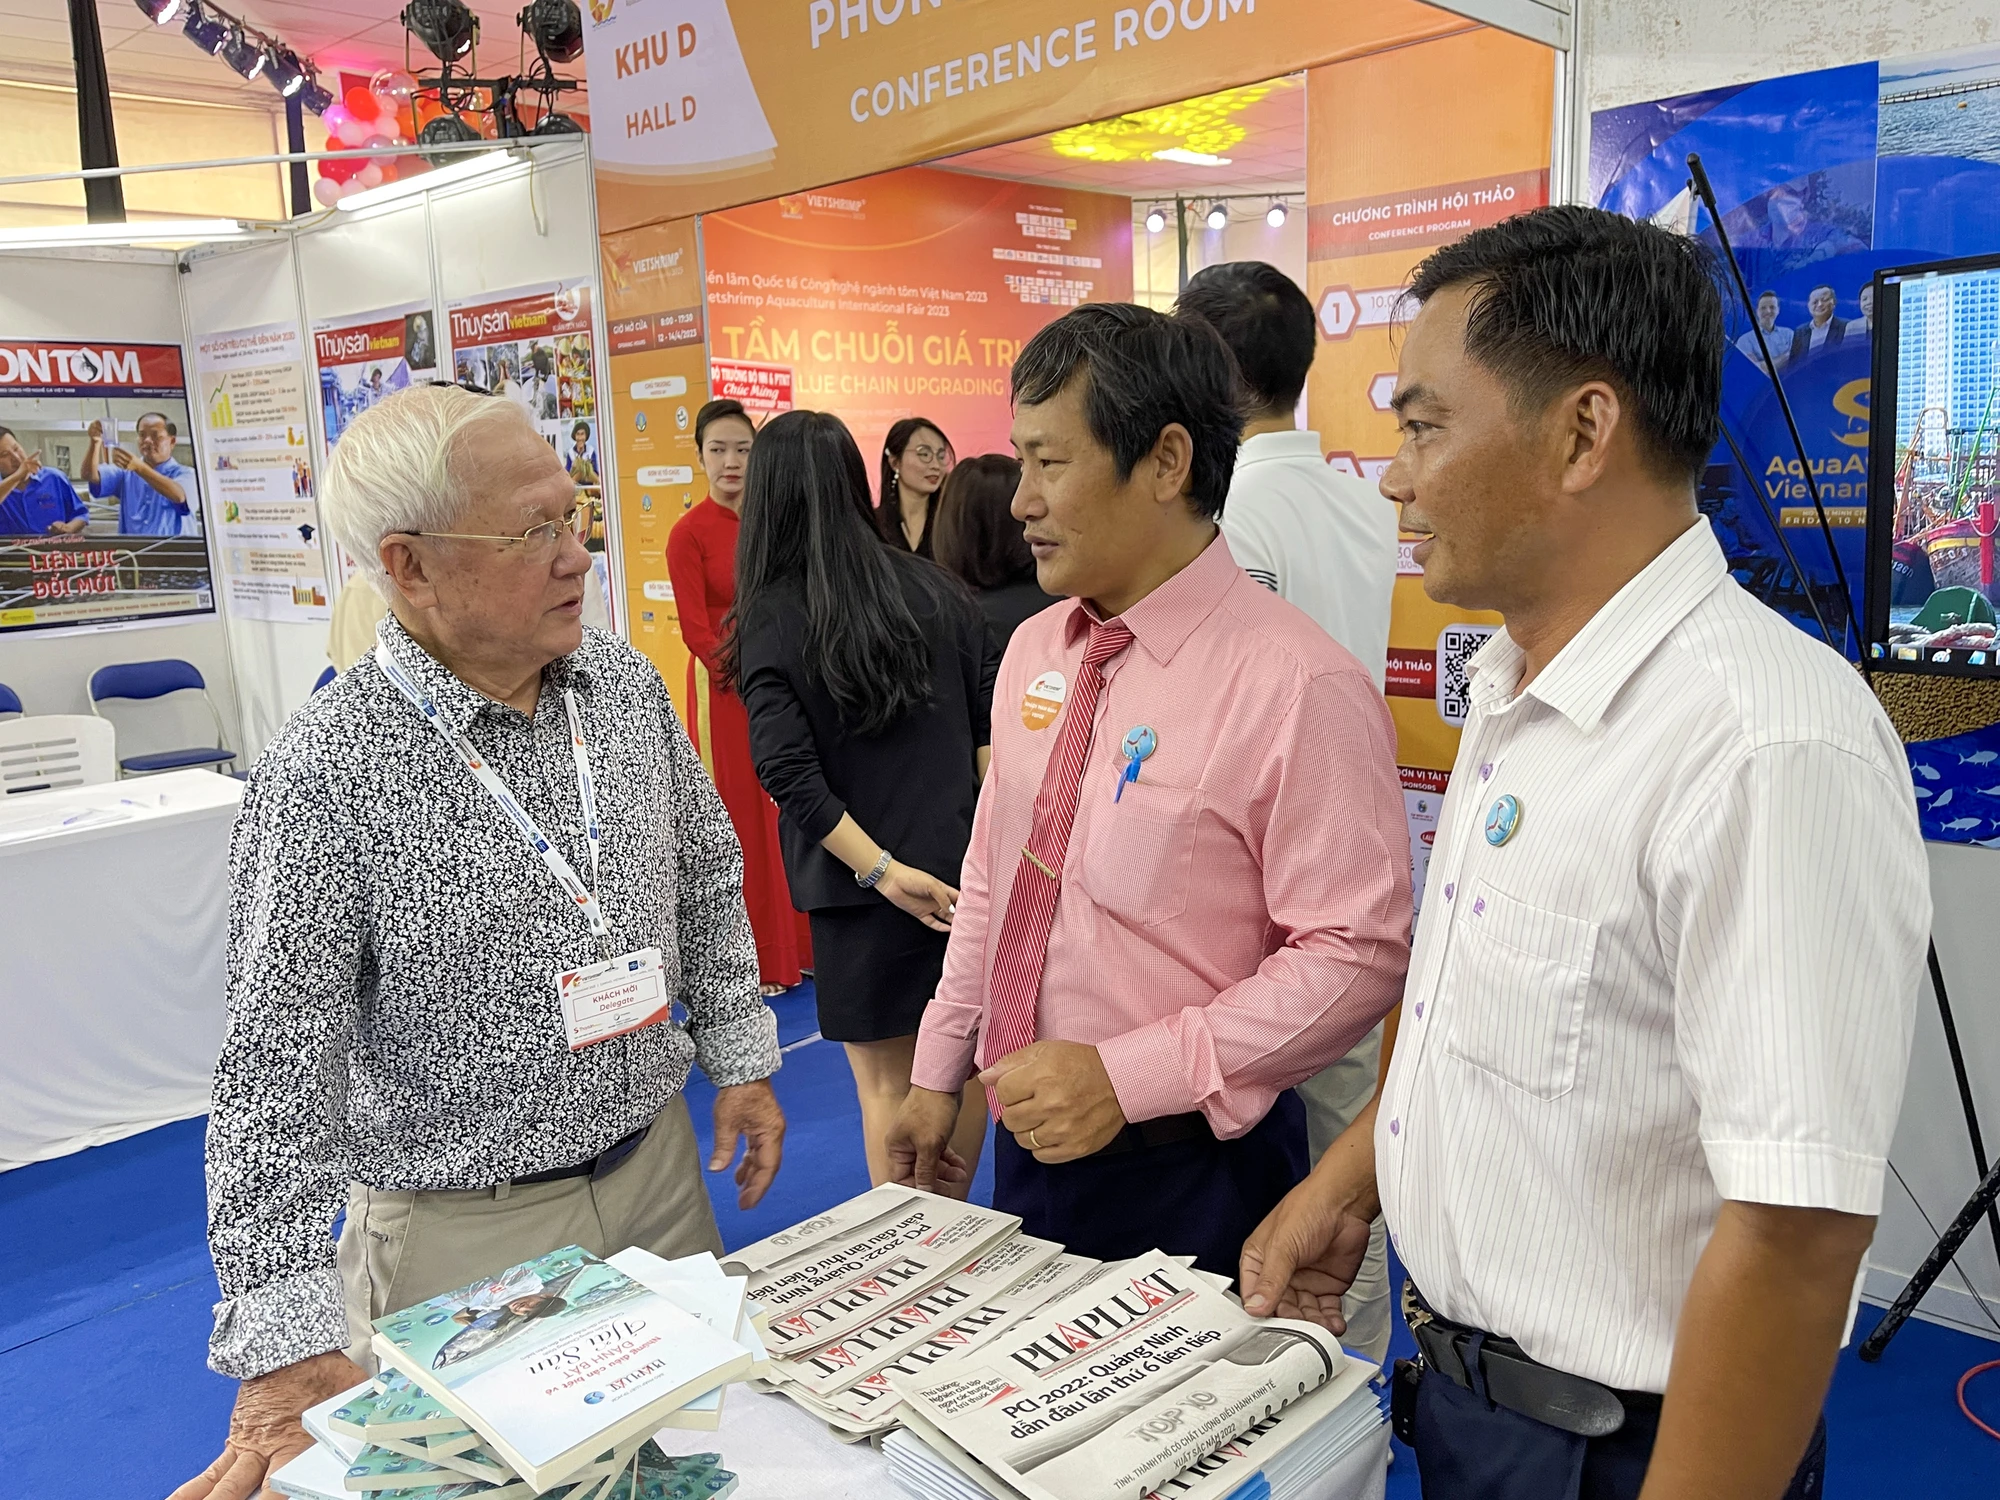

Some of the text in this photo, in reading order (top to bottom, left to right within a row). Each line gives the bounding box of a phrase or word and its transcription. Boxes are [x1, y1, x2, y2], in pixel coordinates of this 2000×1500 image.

[615, 22, 697, 80] KHU D
[850, 18, 1098, 123] CONFERENCE
[626, 95, 697, 139] HALL D
[1332, 184, 1516, 227] CHƯƠNG TRÌNH HỘI THẢO
[1368, 218, 1472, 242] CONFERENCE PROGRAM
[726, 271, 750, 287] lãm
[752, 274, 784, 290] Quốc
[786, 275, 798, 290] tế
[862, 282, 897, 298] ngành
[898, 284, 919, 298] tôm
[920, 286, 940, 302] Việt
[942, 289, 964, 302] Nam
[965, 290, 988, 303] 2023
[708, 291, 950, 317] etshrimp Aquaculture International Fair 2023
[1332, 302, 1340, 325] 1
[510, 313, 548, 330] vietnam
[370, 336, 400, 350] vietnam
[658, 334, 664, 342] 12
[722, 314, 801, 362] TẦM
[811, 320, 914, 364] CHUỖI
[924, 330, 974, 366] GIÁ
[723, 382, 779, 400] Chúc Mừng
[840, 376, 898, 396] CHAIN
[904, 376, 1004, 397] UPGRADING
[1765, 453, 1868, 480] AquaA
[1764, 478, 1868, 500] Viena
[1405, 658, 1432, 672] THẢO
[1416, 770, 1425, 781] VỊ
[1427, 771, 1442, 781] TÀI
[592, 982, 638, 1004] KHÁCH MỜI
[599, 996, 635, 1012] Delegate
[902, 1223, 932, 1240] PCI
[745, 1212, 925, 1301] dẫn đầu lần thứ 6 liên tiếp
[860, 1238, 905, 1262] 2022:
[807, 1261, 864, 1288] Quảng
[770, 1284, 814, 1305] Ninh
[525, 1346, 580, 1376] Sản
[544, 1336, 662, 1396] Những điều cần biết về
[1001, 1398, 1040, 1420] PCI
[1038, 1375, 1094, 1406] 2022:
[1088, 1344, 1154, 1378] Quảng
[1143, 1323, 1189, 1353] Ninh
[1009, 1416, 1050, 1440] dẫn
[1048, 1400, 1087, 1422] đầu
[1084, 1384, 1118, 1406] lần
[1110, 1366, 1148, 1388] thứ
[1142, 1357, 1160, 1374] 6
[1157, 1344, 1193, 1366] liên
[1186, 1328, 1222, 1350] tiếp
[1125, 1407, 1184, 1443] TOP
[1132, 1456, 1160, 1478] THÀNH
[1157, 1446, 1174, 1464] PHỐ
[1171, 1442, 1182, 1454] CÓ
[1180, 1430, 1200, 1448] CHẤT
[1199, 1418, 1222, 1438] LƯỢNG
[1234, 1396, 1254, 1412] HÀNH
[1251, 1386, 1270, 1404] KINH
[1265, 1378, 1277, 1391] TẾ
[1173, 1452, 1192, 1470] XUẤT
[1220, 1422, 1236, 1440] 2022
